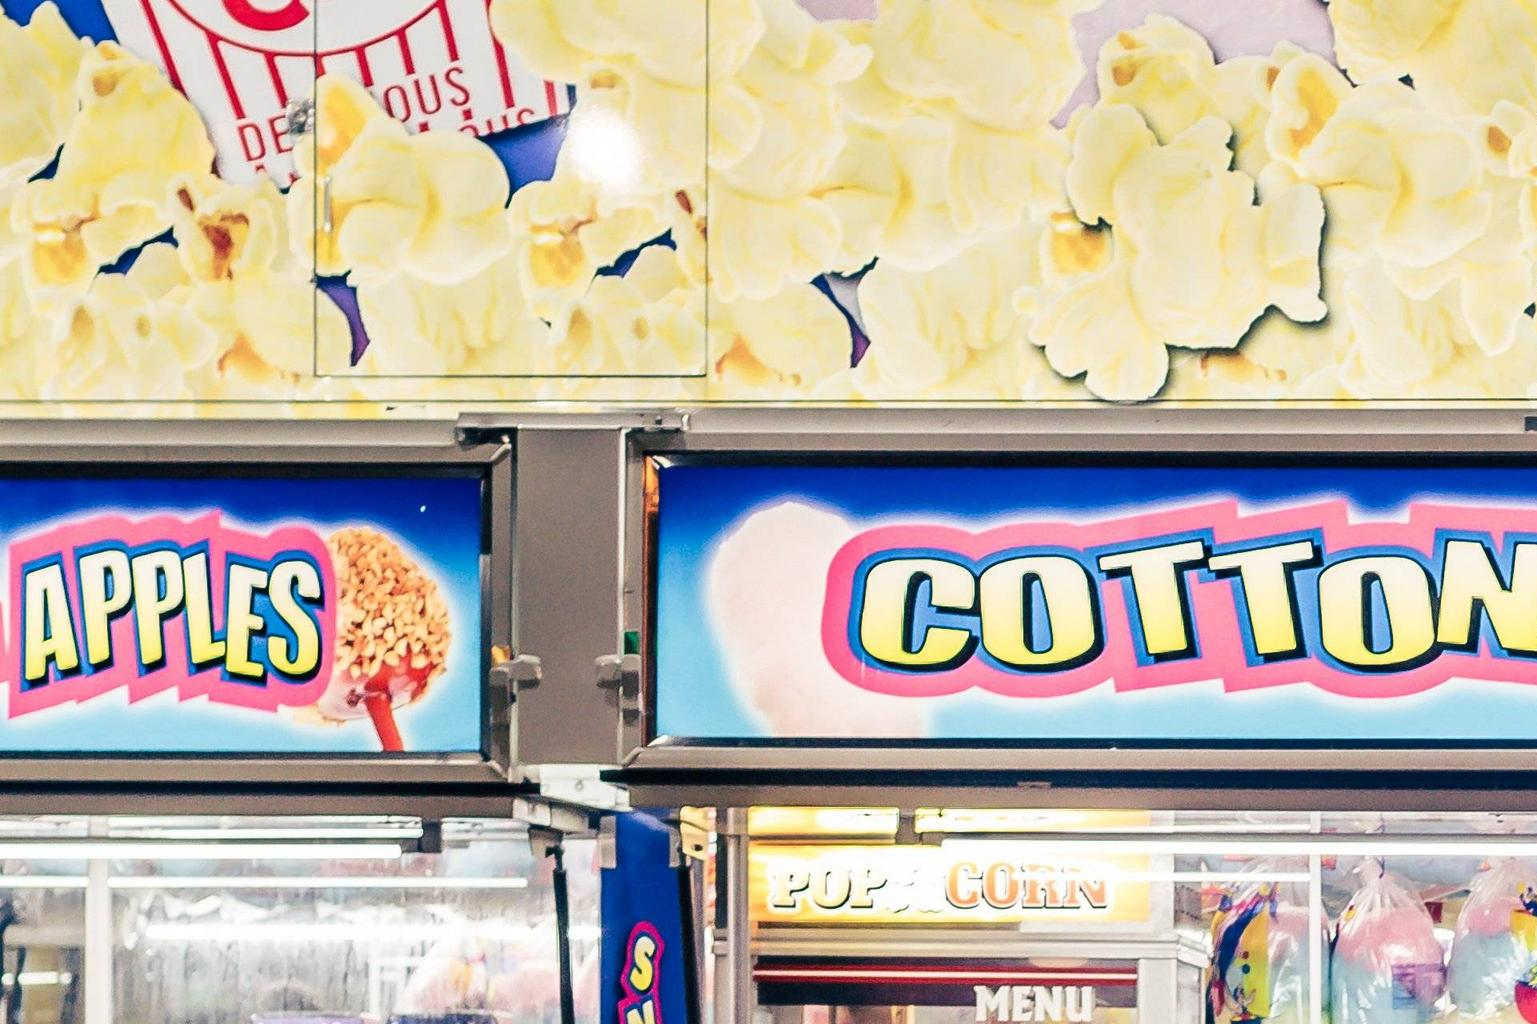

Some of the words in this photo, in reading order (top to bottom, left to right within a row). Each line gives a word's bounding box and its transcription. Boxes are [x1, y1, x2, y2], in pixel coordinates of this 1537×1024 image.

[22, 548, 325, 686] APPLES
[773, 863, 889, 909] POP
[945, 862, 1109, 910] CORN
[974, 985, 1094, 1022] MENU
